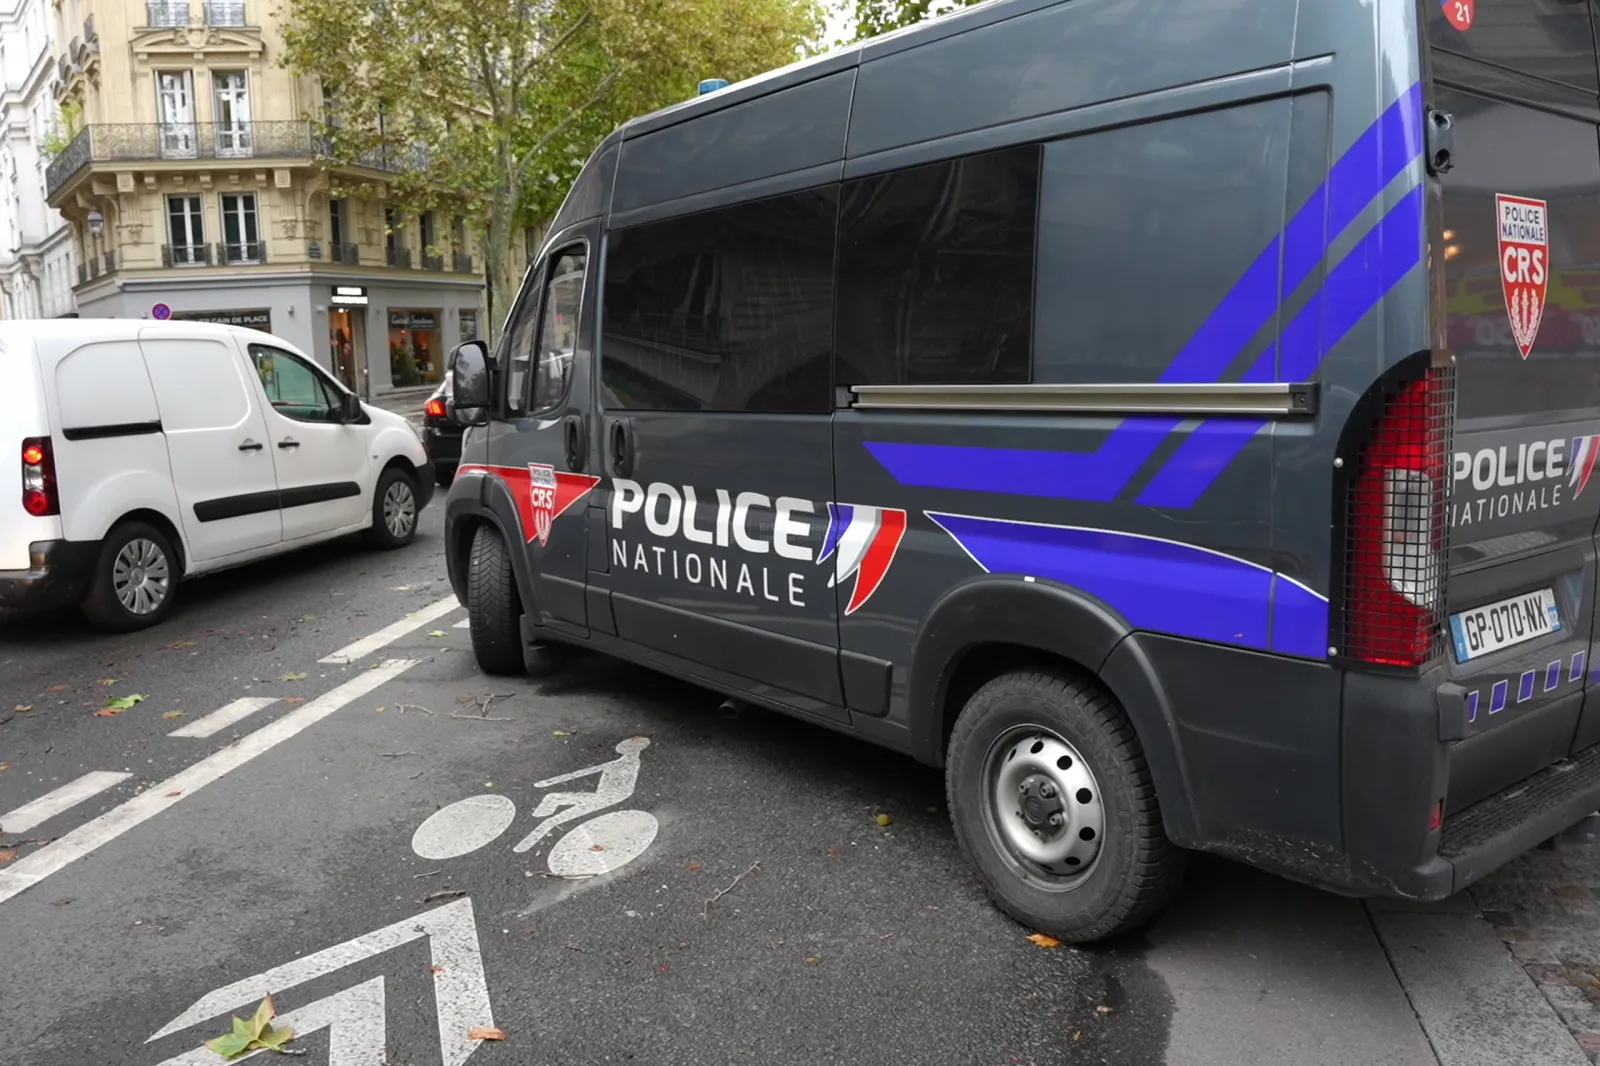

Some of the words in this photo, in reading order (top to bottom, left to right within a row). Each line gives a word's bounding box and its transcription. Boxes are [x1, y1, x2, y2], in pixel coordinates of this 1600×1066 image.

[1455, 1, 1470, 24] 21
[1504, 206, 1540, 225] POLICE
[1502, 225, 1544, 242] NATIONALE
[1503, 246, 1544, 284] CRS
[231, 316, 242, 324] DE
[244, 314, 268, 323] PLACE
[1454, 438, 1566, 494] POLICE
[531, 488, 553, 510] CRS
[612, 478, 814, 561] POLICE
[613, 539, 806, 607] NATIONALE
[1465, 595, 1548, 651] GP-070-NX
